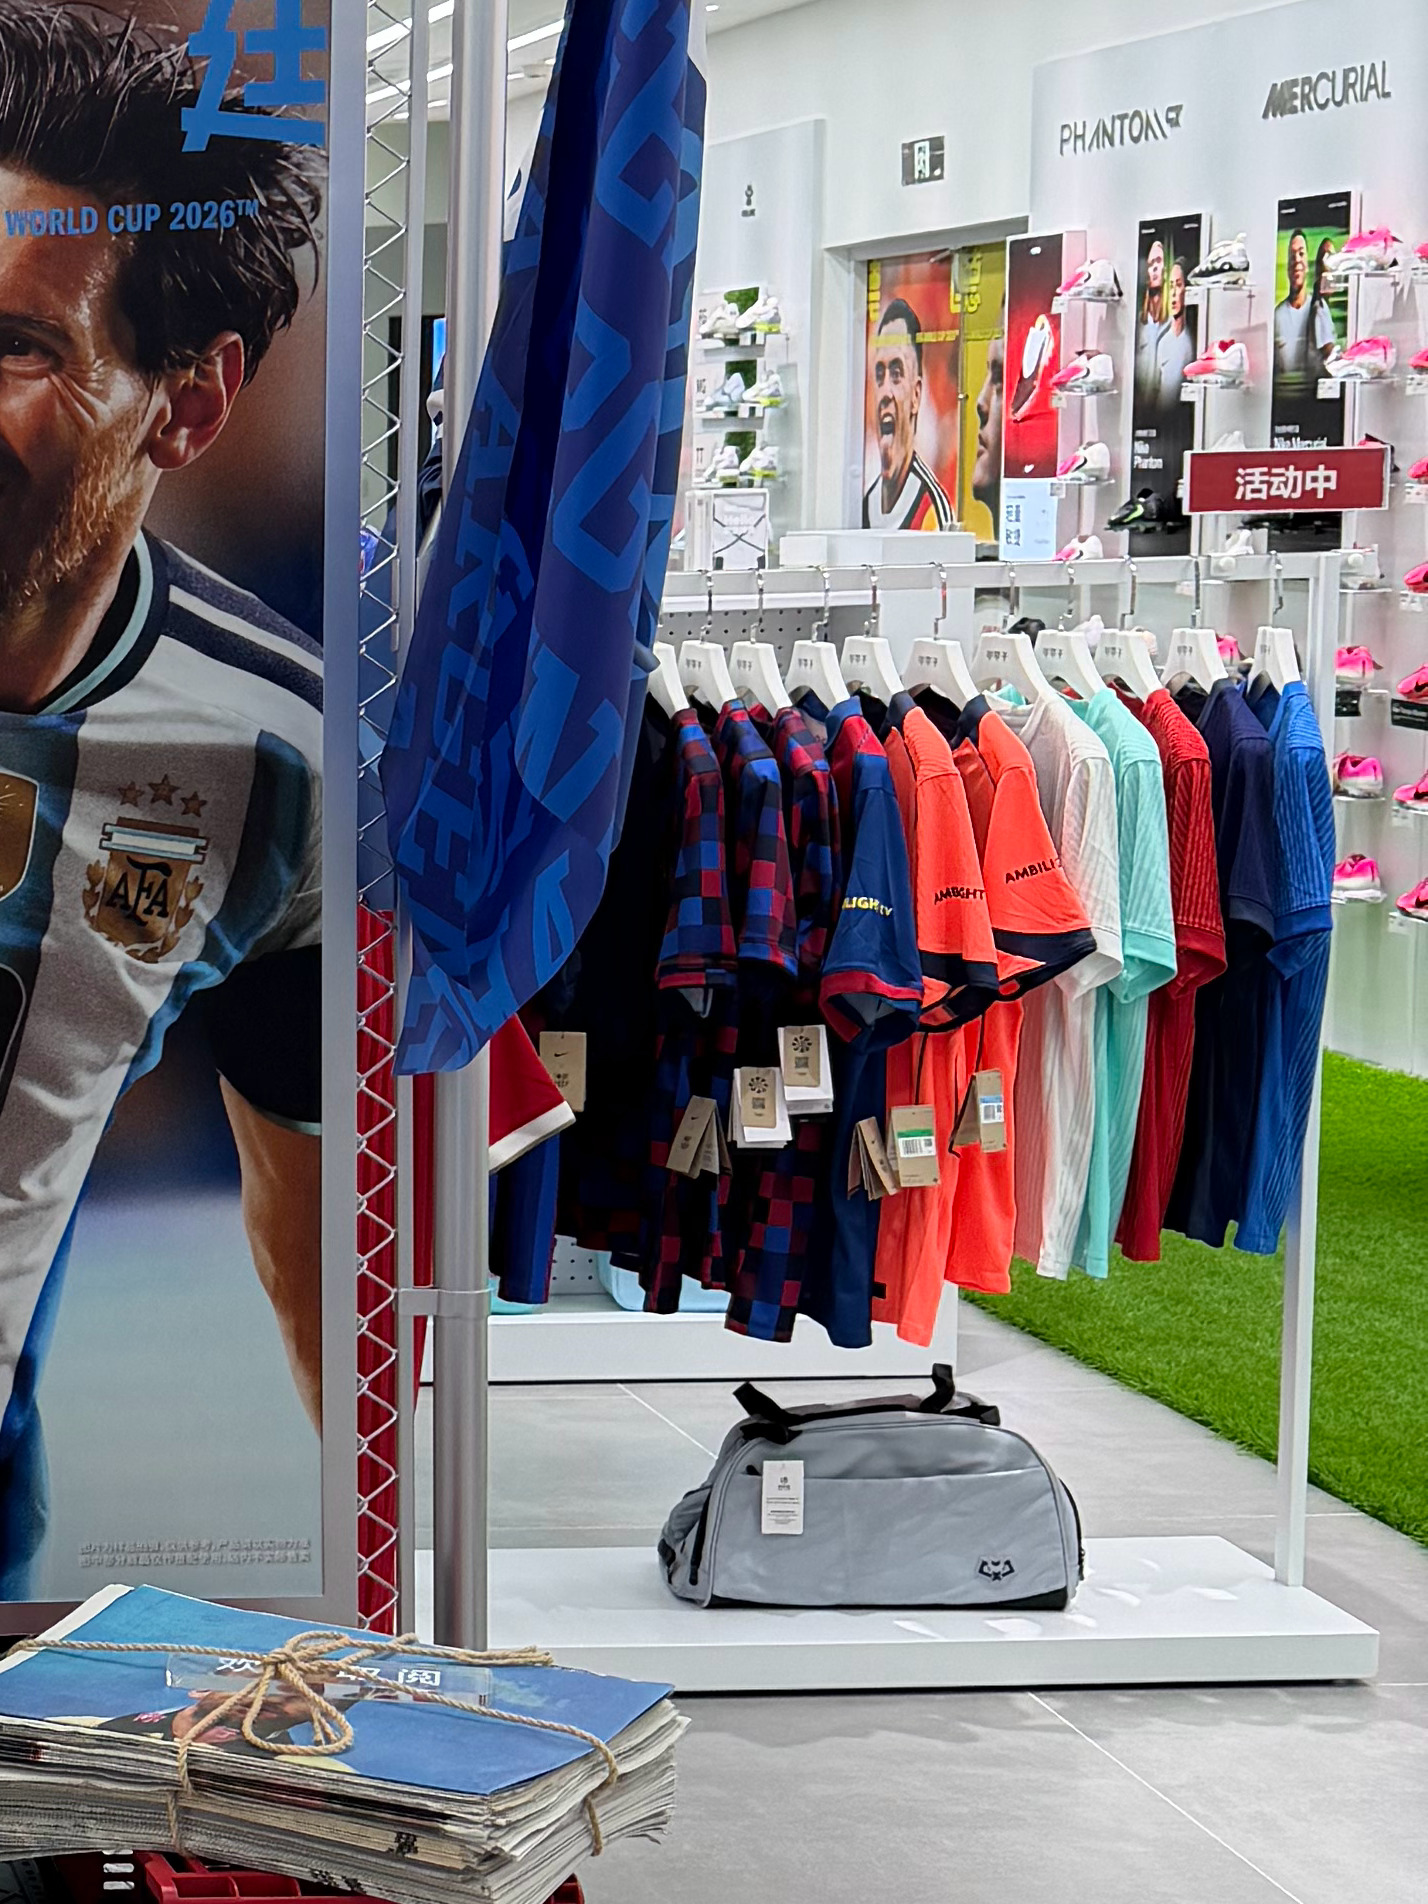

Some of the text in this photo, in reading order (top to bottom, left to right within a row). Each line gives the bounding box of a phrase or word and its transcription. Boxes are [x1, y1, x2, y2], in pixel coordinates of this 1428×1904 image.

[1261, 60, 1392, 119] MERCURIAL
[3, 205, 98, 238] WORLD
[106, 202, 161, 234] CUP
[1235, 464, 1338, 501] 活动中
